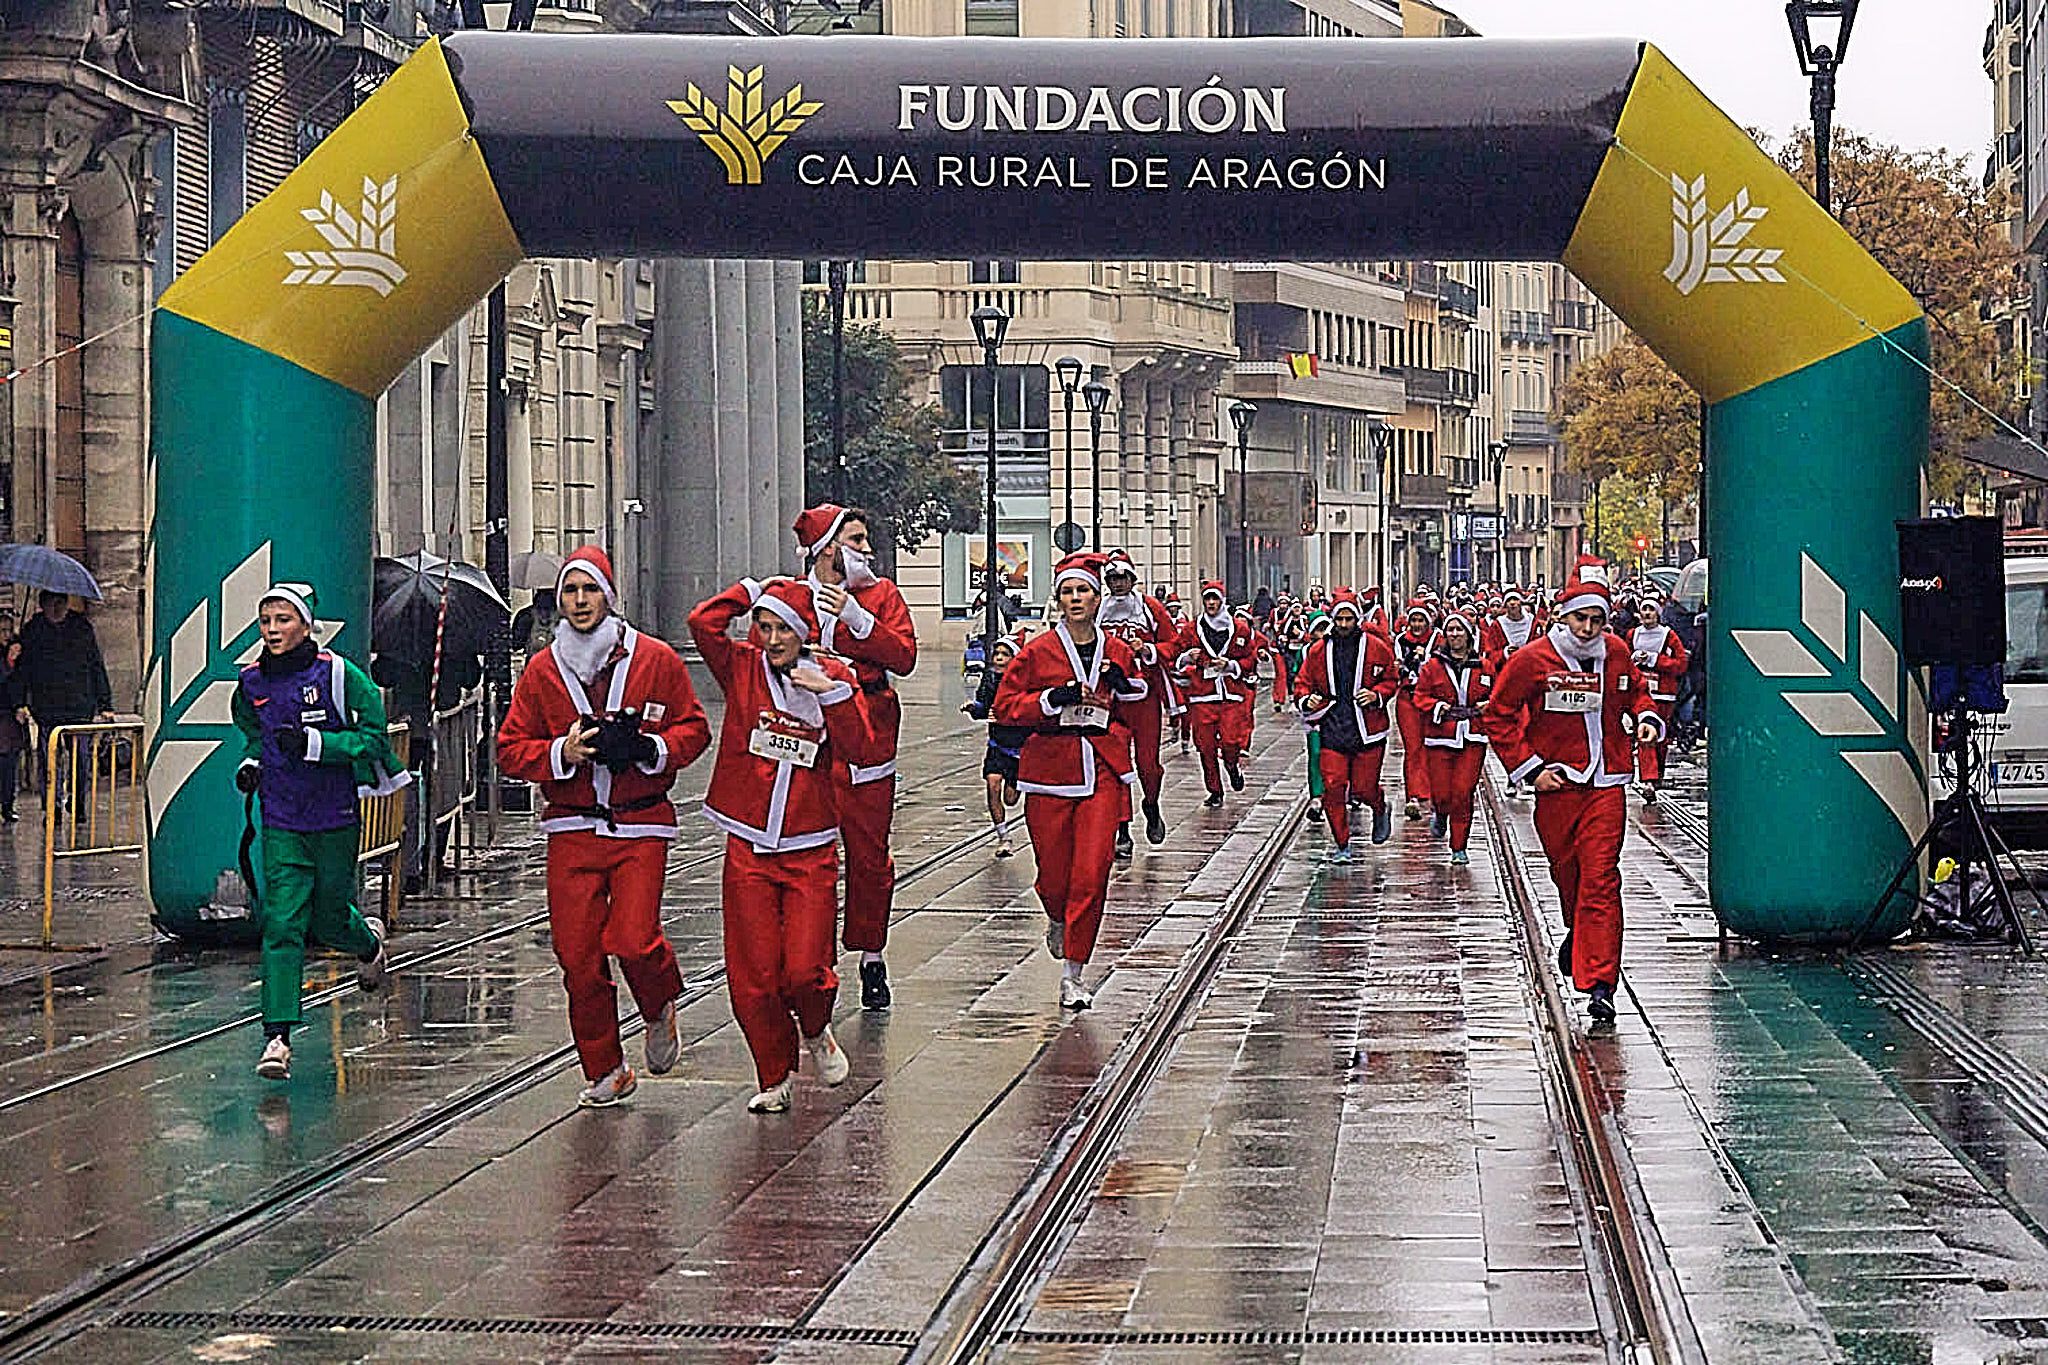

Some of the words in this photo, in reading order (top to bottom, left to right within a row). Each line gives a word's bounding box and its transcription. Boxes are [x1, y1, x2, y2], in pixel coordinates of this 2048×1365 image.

[898, 75, 1287, 134] FUNDACIÓN
[798, 154, 918, 186] CAJA
[938, 155, 1092, 188] RURAL
[1110, 157, 1169, 189] DE
[1187, 152, 1386, 190] ARAGÓN
[768, 734, 800, 753] 3353
[2001, 764, 2046, 782] 4745
